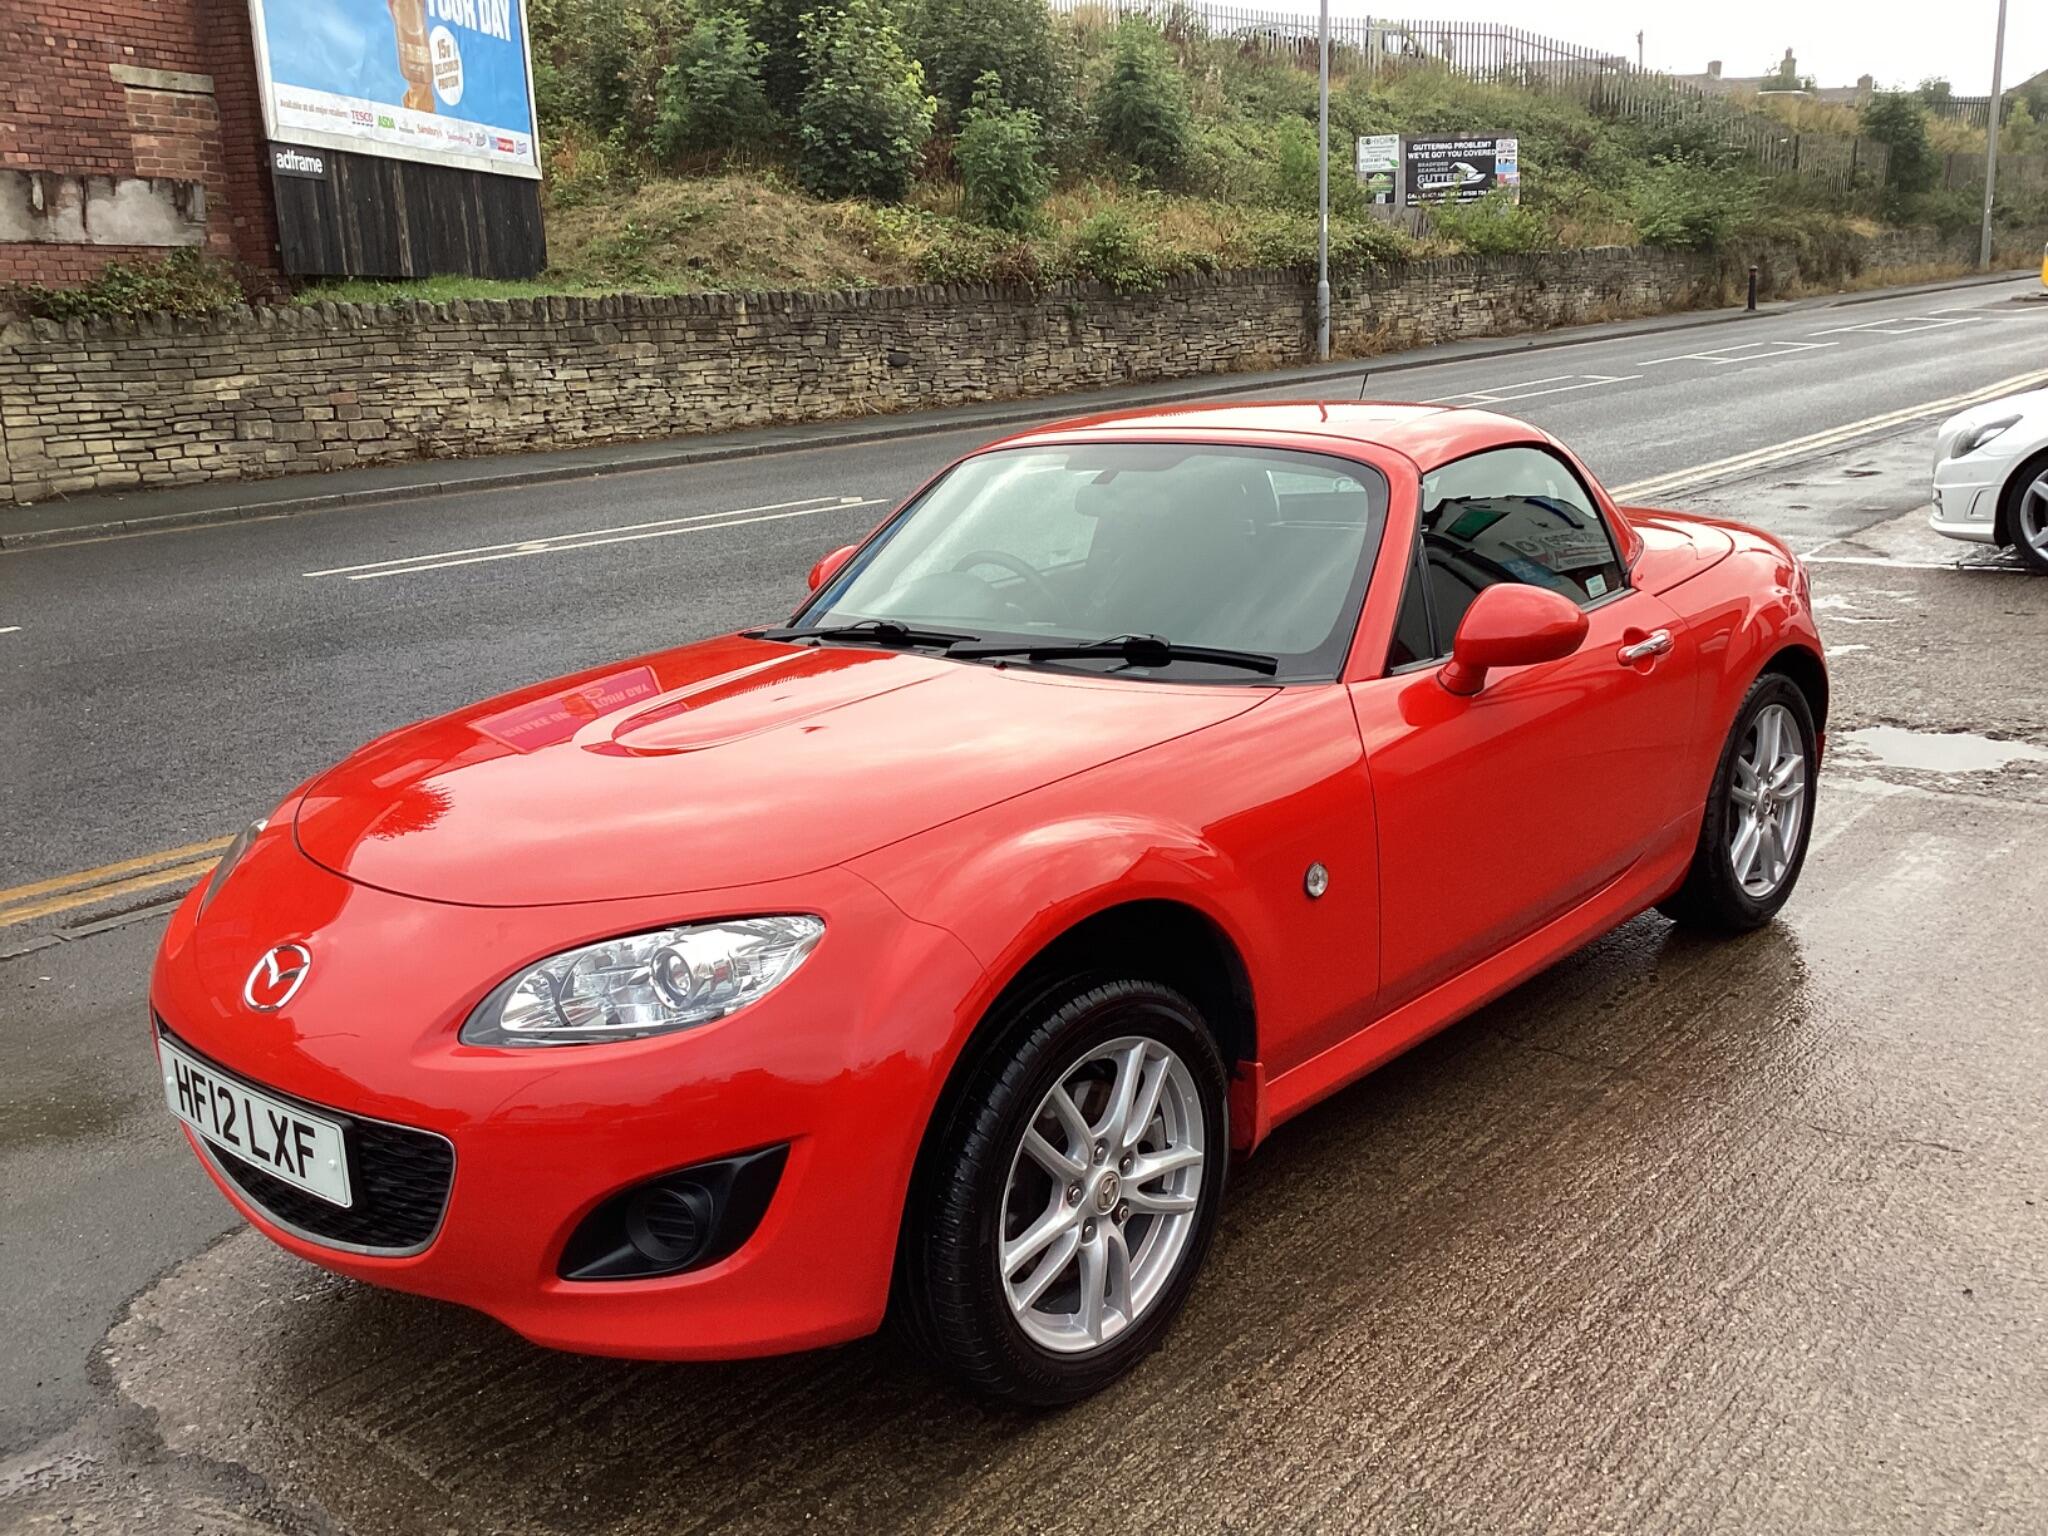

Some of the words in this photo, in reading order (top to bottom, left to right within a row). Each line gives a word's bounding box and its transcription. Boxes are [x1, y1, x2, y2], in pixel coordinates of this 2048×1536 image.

[478, 0, 511, 42] DAY
[351, 110, 374, 123] TESCO
[378, 115, 396, 131] ASDA
[1408, 151, 1430, 159] WE'VE
[1447, 150, 1462, 158] YOU
[1463, 149, 1497, 157] COVERED
[1413, 143, 1453, 151] GUTTERING
[1454, 141, 1492, 149] PROBLEM?
[276, 150, 323, 174] adframe
[174, 1058, 240, 1147] HF12
[244, 1098, 315, 1179] LXF
